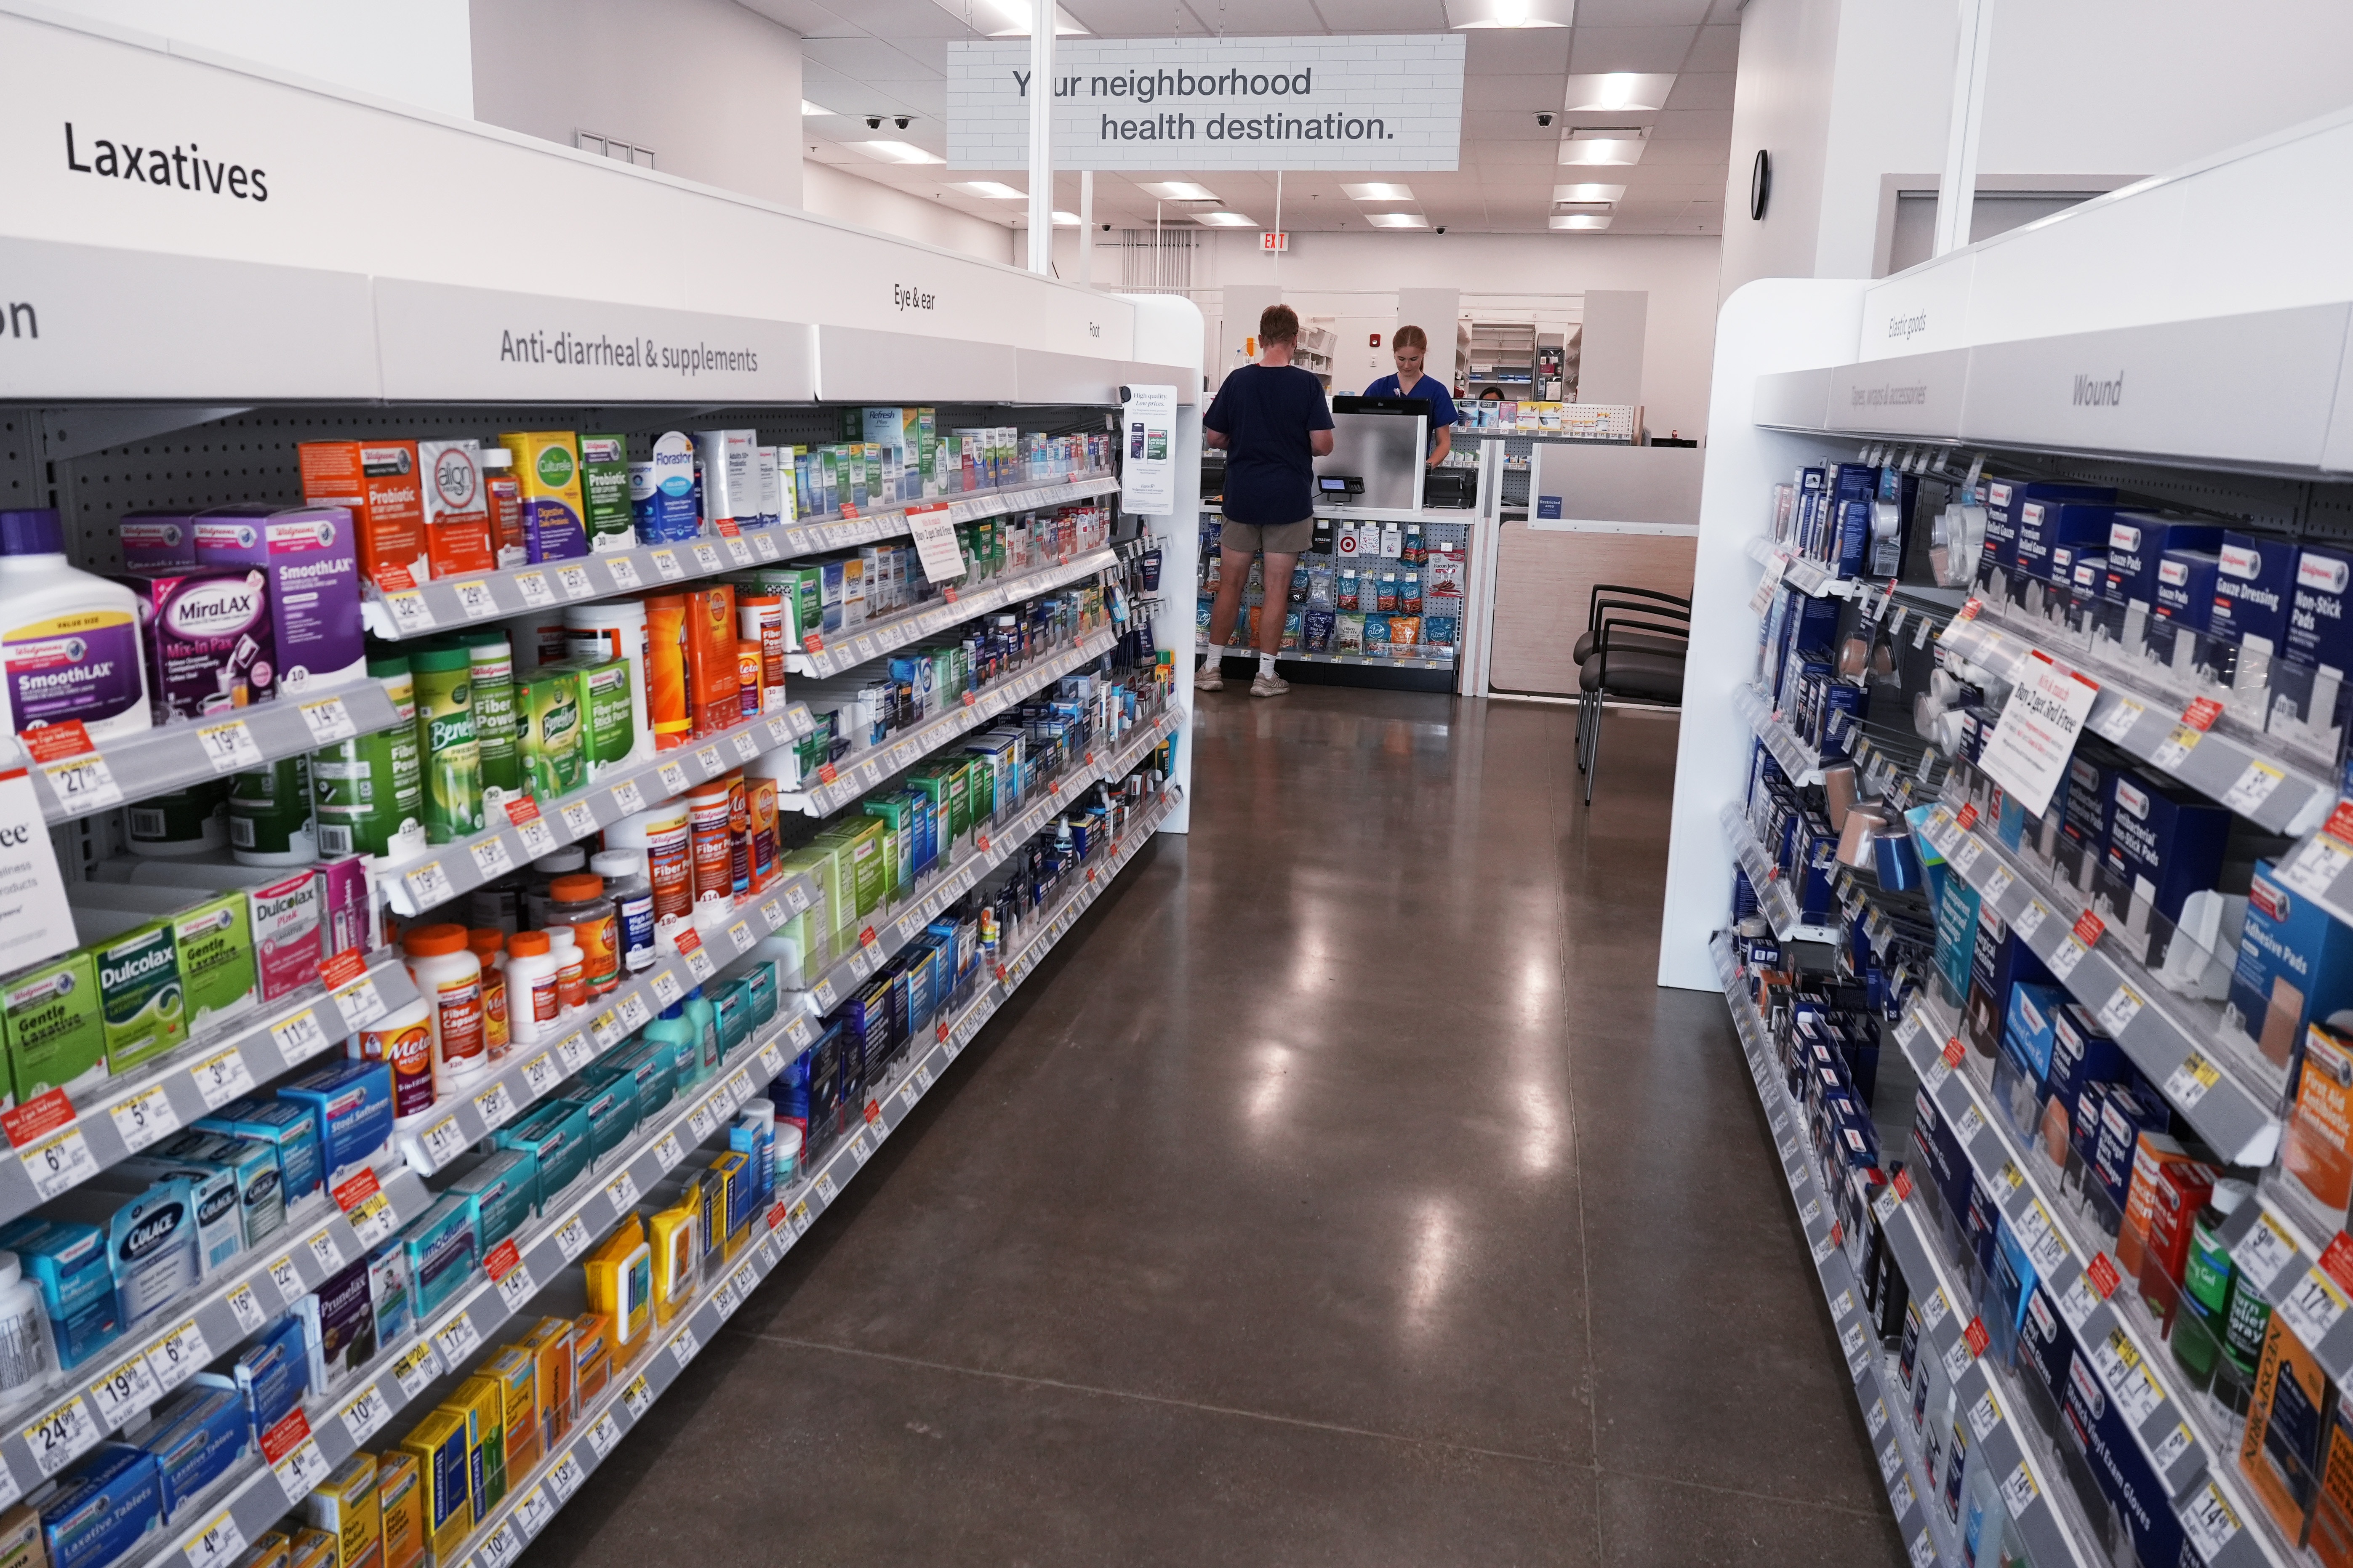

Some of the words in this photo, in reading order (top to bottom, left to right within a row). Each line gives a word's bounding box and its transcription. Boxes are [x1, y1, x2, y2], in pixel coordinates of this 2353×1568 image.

[1013, 70, 1082, 97] Yur
[1092, 68, 1311, 102] neighborhood
[1101, 112, 1194, 141] health
[1206, 112, 1394, 140] destination.
[64, 122, 268, 202] Laxatives
[1265, 234, 1285, 249] EXT
[894, 284, 911, 311] Eye
[913, 287, 919, 308] &
[921, 292, 935, 310] ear
[1089, 322, 1100, 338] Foot
[1889, 313, 1907, 338] Elastic
[1907, 309, 1926, 340] goods
[500, 330, 641, 367] Anti-diarrheal
[645, 339, 658, 368] &
[662, 342, 758, 376] supplements
[2073, 370, 2124, 407] Wound
[869, 411, 895, 420] Refresh
[656, 452, 692, 466] Florastor
[438, 464, 472, 495] align
[589, 472, 626, 487] Probiotic
[369, 487, 415, 505] Probiotic
[279, 558, 353, 580] SmoothLAX
[179, 593, 251, 621] MiraLAX
[18, 662, 114, 692] SmoothLAX
[474, 699, 511, 715] Fiber
[476, 710, 515, 727] Powd
[696, 843, 722, 854] Fiber
[653, 864, 681, 878] Fiber
[0, 877, 37, 896] roducts
[703, 893, 718, 902] 114
[256, 887, 315, 922] Dulcolax
[187, 937, 224, 960] Gentle
[188, 945, 237, 973] Laxative
[101, 945, 173, 989] Dulcolax
[19, 1004, 66, 1032] Gentle
[443, 1006, 471, 1020] Fiber
[21, 1013, 82, 1047] Laxative
[321, 1276, 367, 1317] Prunelax
